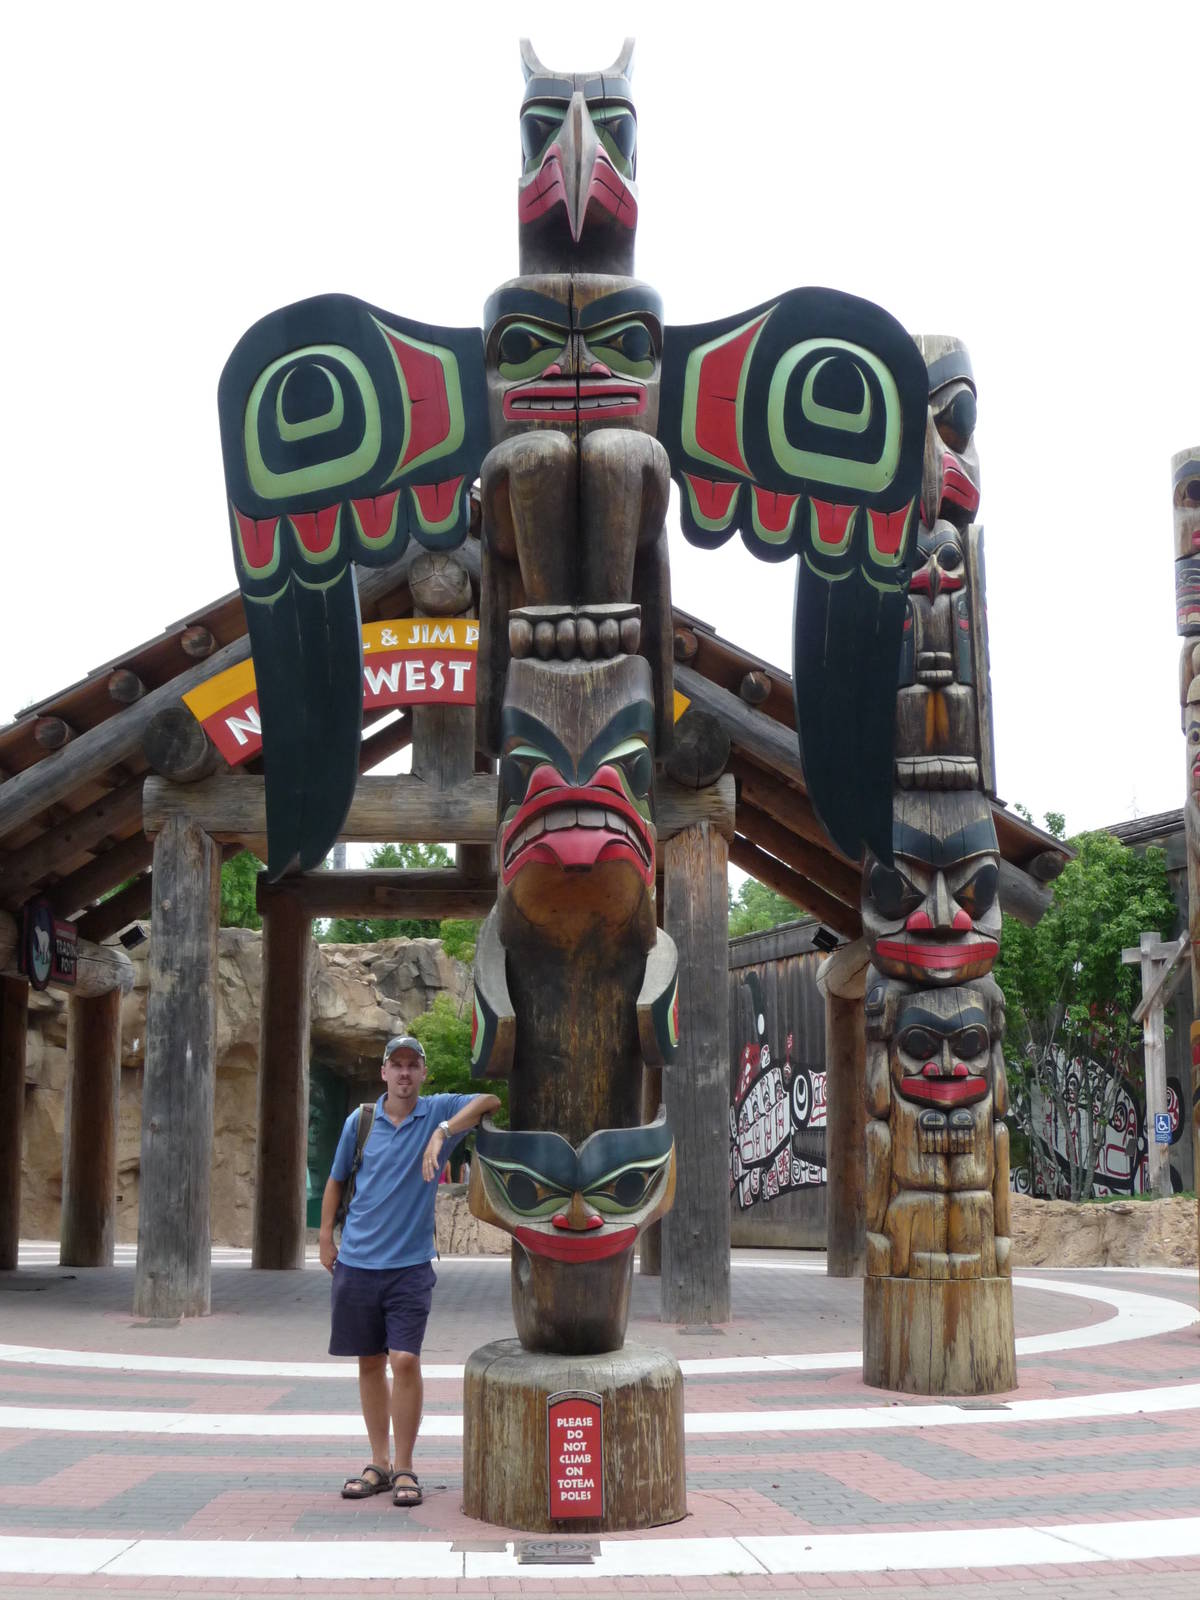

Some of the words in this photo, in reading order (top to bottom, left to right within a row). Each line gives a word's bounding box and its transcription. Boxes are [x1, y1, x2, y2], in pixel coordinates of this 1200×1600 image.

[381, 628, 398, 646] &
[408, 624, 456, 644] JIM
[363, 660, 472, 696] WEST
[556, 1417, 593, 1428] PLEASE
[567, 1430, 583, 1439] DO
[563, 1442, 587, 1451] NOT
[559, 1454, 592, 1463] CLIMB
[565, 1467, 583, 1476] ON
[557, 1479, 594, 1488] TOTEM
[560, 1491, 591, 1501] POLES
